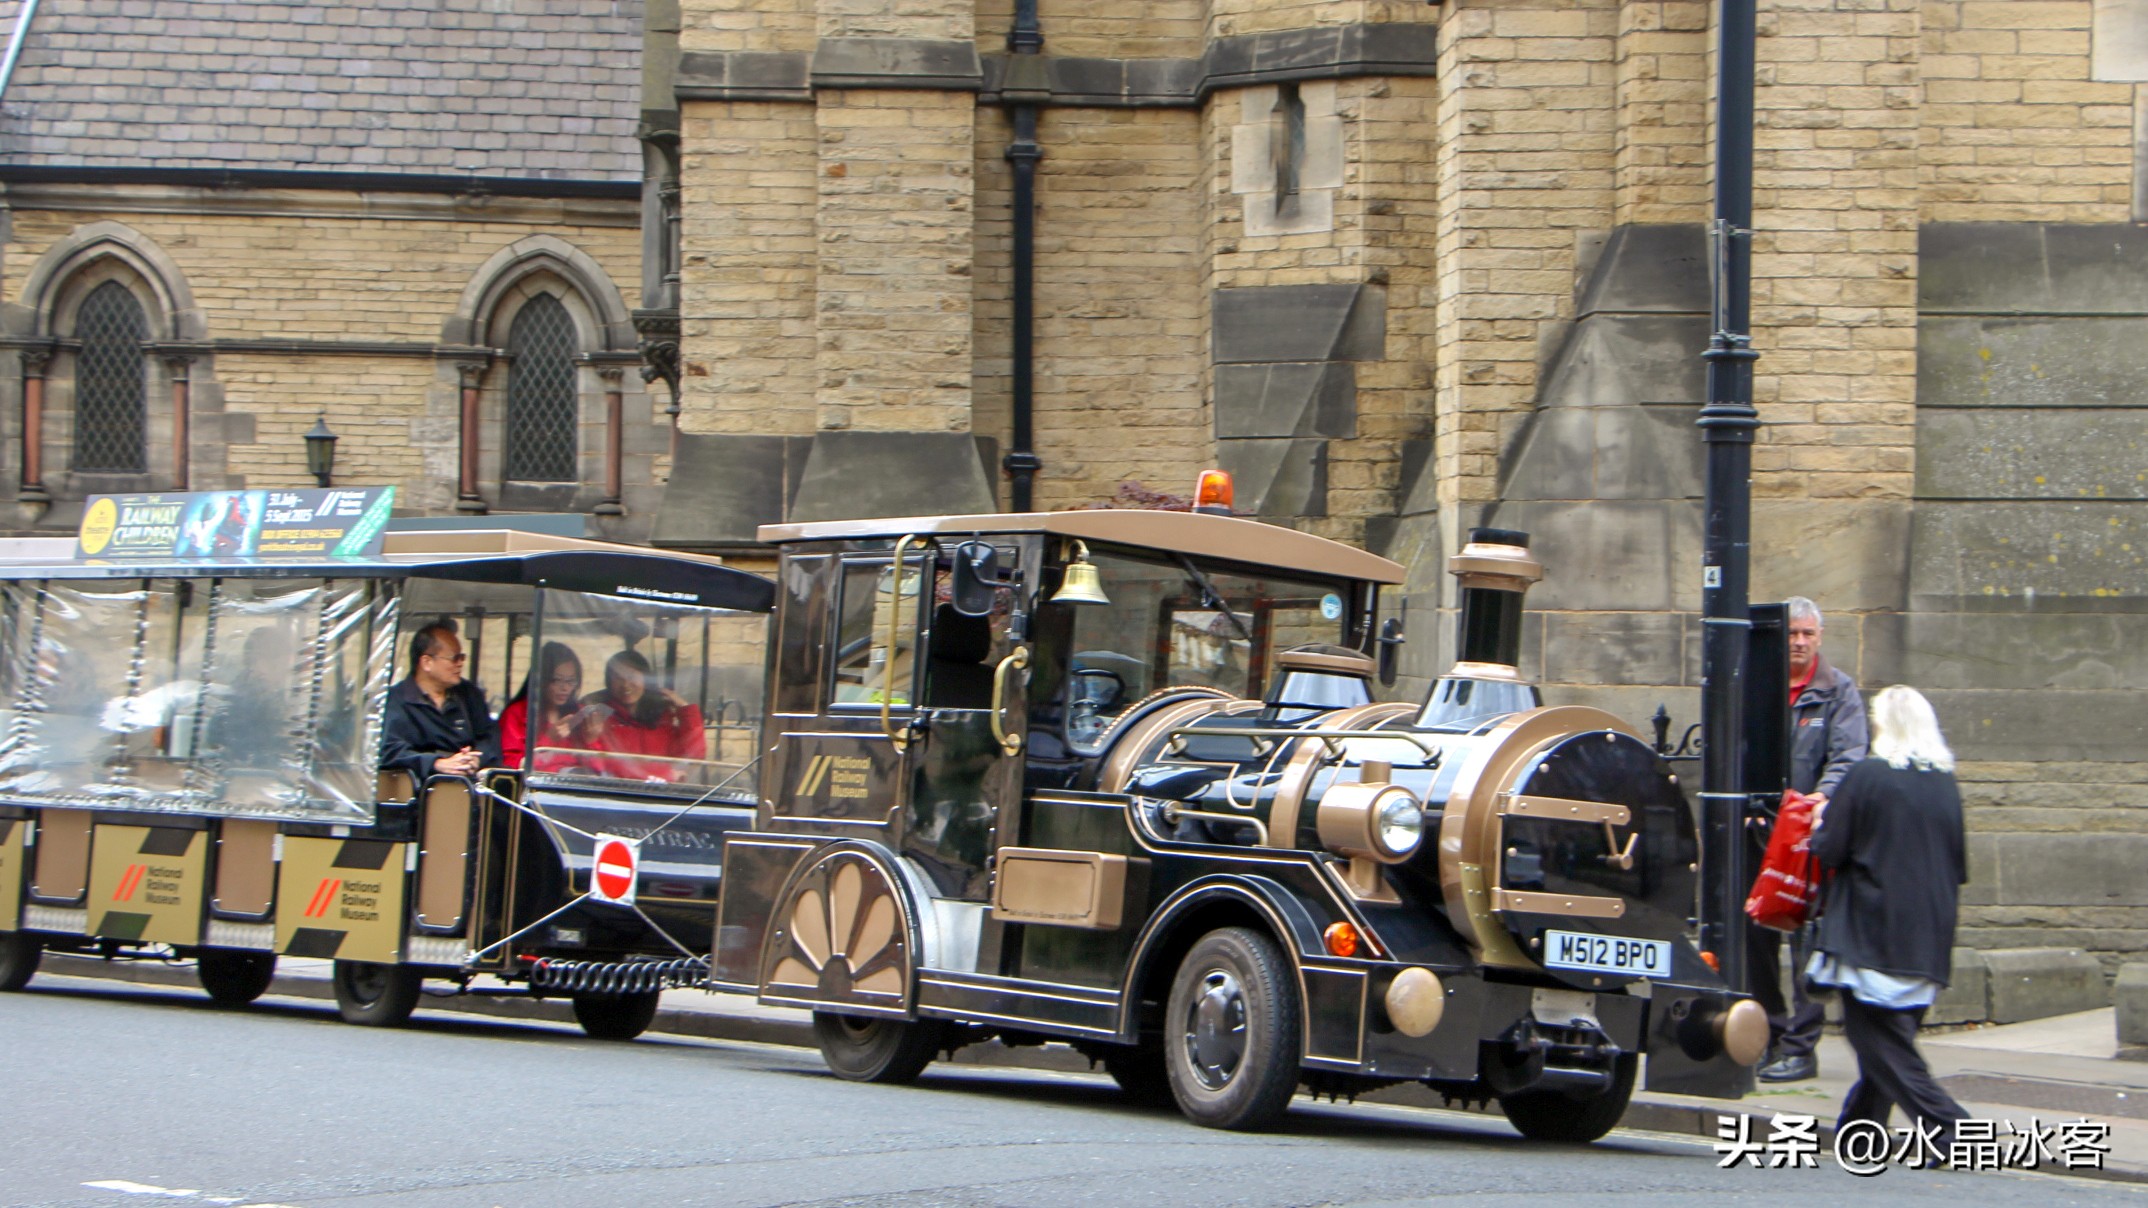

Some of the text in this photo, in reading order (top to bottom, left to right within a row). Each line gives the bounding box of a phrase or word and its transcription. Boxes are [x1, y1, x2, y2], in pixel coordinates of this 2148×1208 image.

[121, 506, 181, 525] RAILWAY
[112, 525, 181, 546] CHILDREN
[1708, 570, 1717, 584] 4
[832, 755, 871, 769] National
[832, 770, 867, 785] Railway
[830, 784, 868, 798] Museum
[148, 866, 183, 879] National
[146, 878, 179, 893] Railway
[342, 880, 381, 893] National
[145, 891, 181, 906] Museum
[341, 893, 377, 909] Railway
[340, 907, 379, 921] Museum
[1560, 935, 1657, 969] M512 BPO
